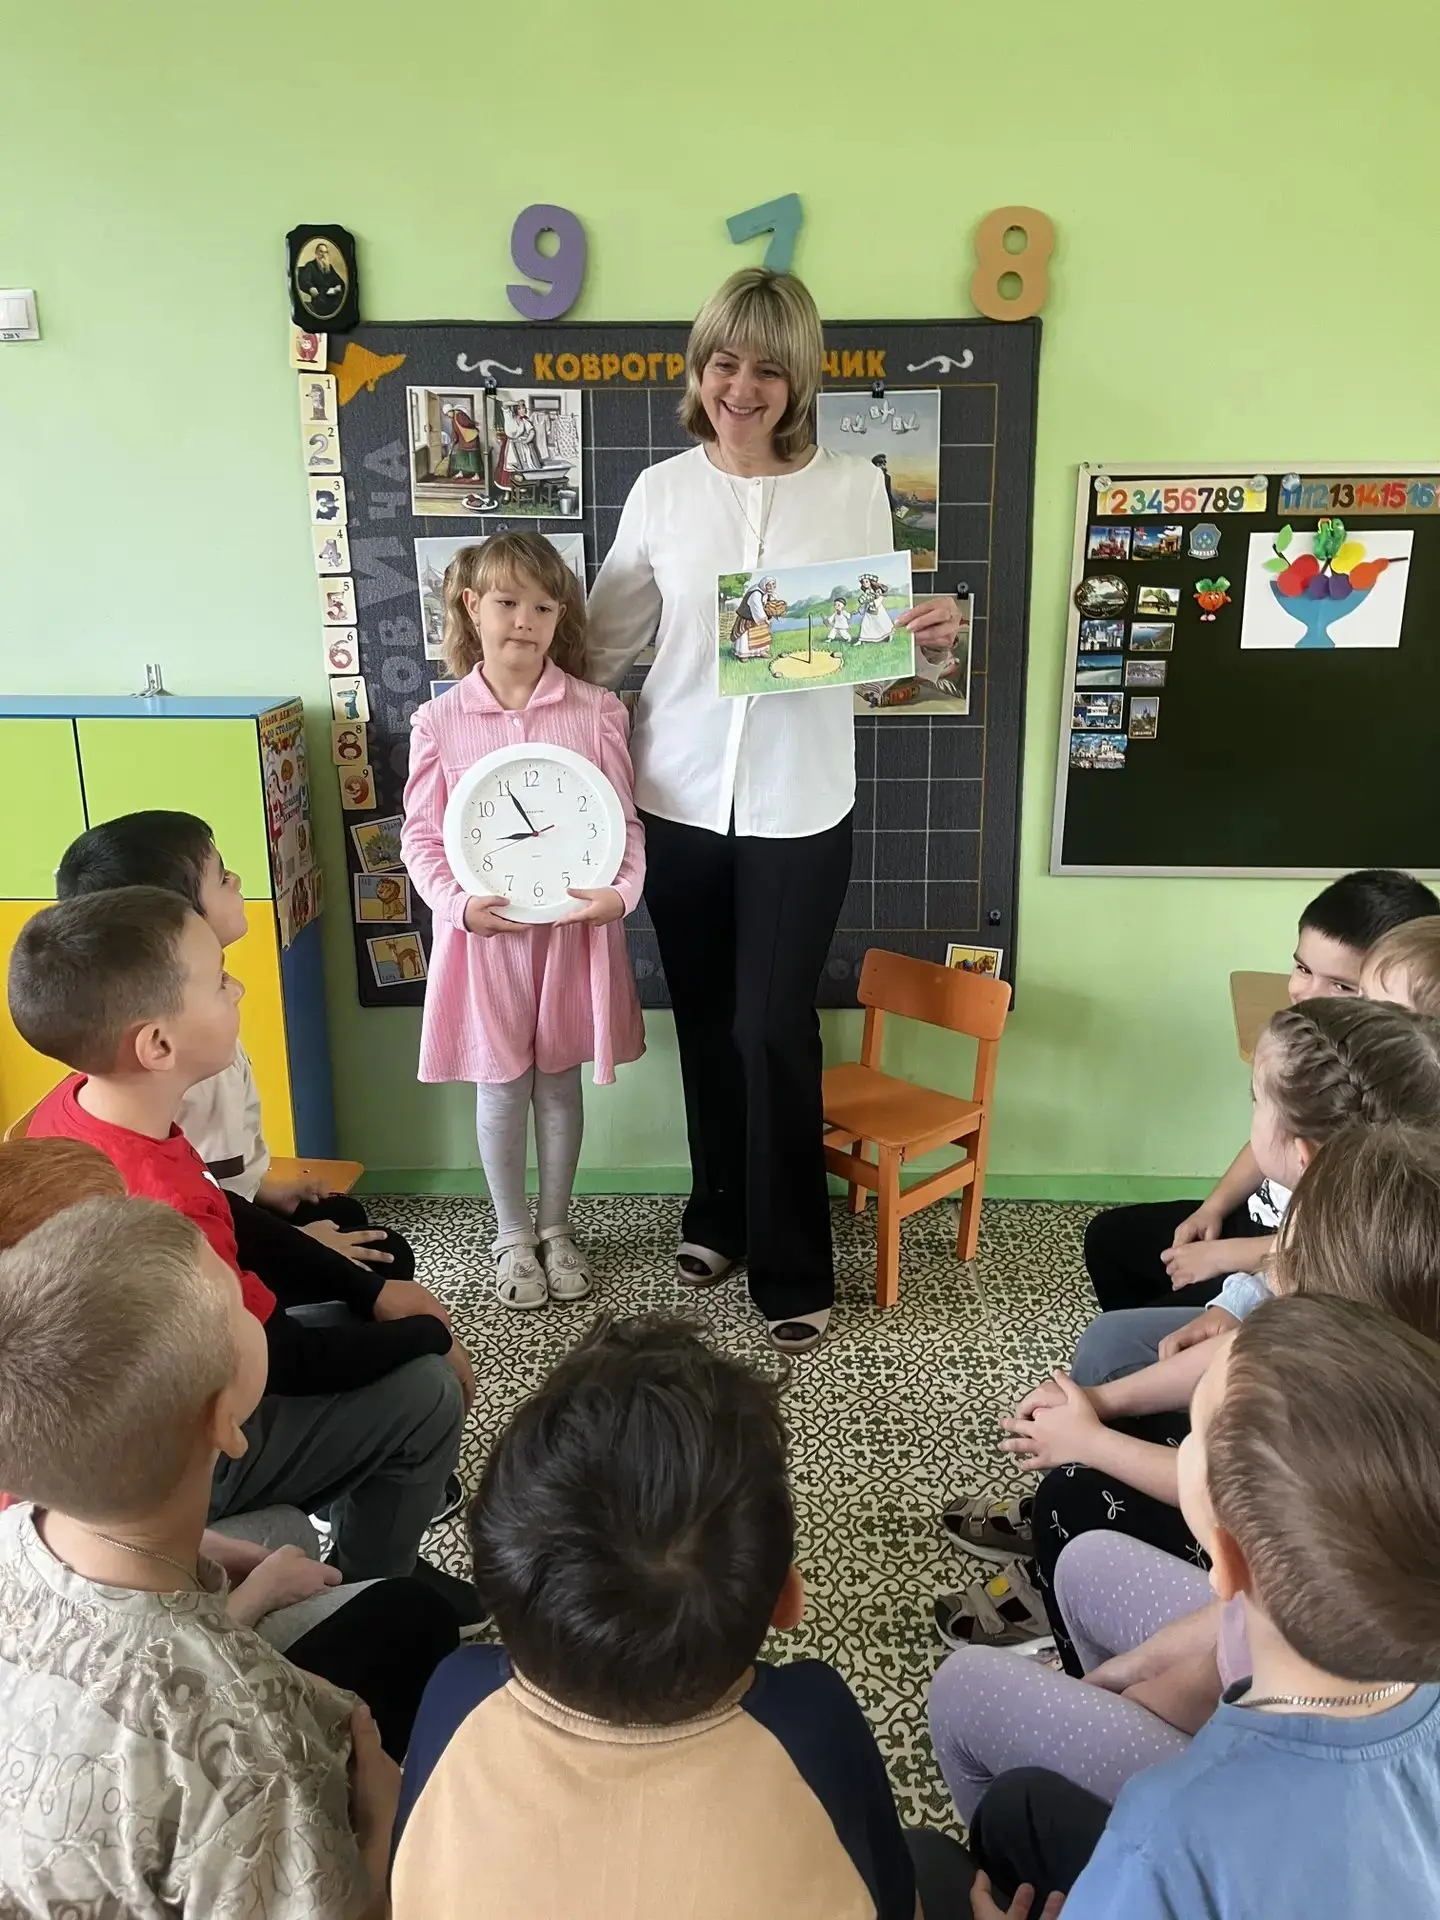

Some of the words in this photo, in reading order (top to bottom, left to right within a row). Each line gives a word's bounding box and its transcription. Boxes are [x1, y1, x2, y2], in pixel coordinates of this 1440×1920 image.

[507, 203, 587, 320] 9
[726, 192, 801, 276] 7
[970, 205, 1057, 321] 8
[533, 352, 686, 382] КОВРОГР
[819, 350, 887, 379] ЧИК
[523, 770, 540, 788] 12
[556, 777, 563, 793] 1
[497, 780, 511, 797] 11
[478, 800, 495, 818] 10
[577, 795, 588, 812] 2
[470, 828, 482, 845] 9
[587, 822, 597, 839] 3
[482, 855, 494, 872] 8
[582, 851, 591, 866] 4
[504, 874, 514, 891] 7
[561, 871, 571, 888] 5
[533, 880, 544, 898] 6
